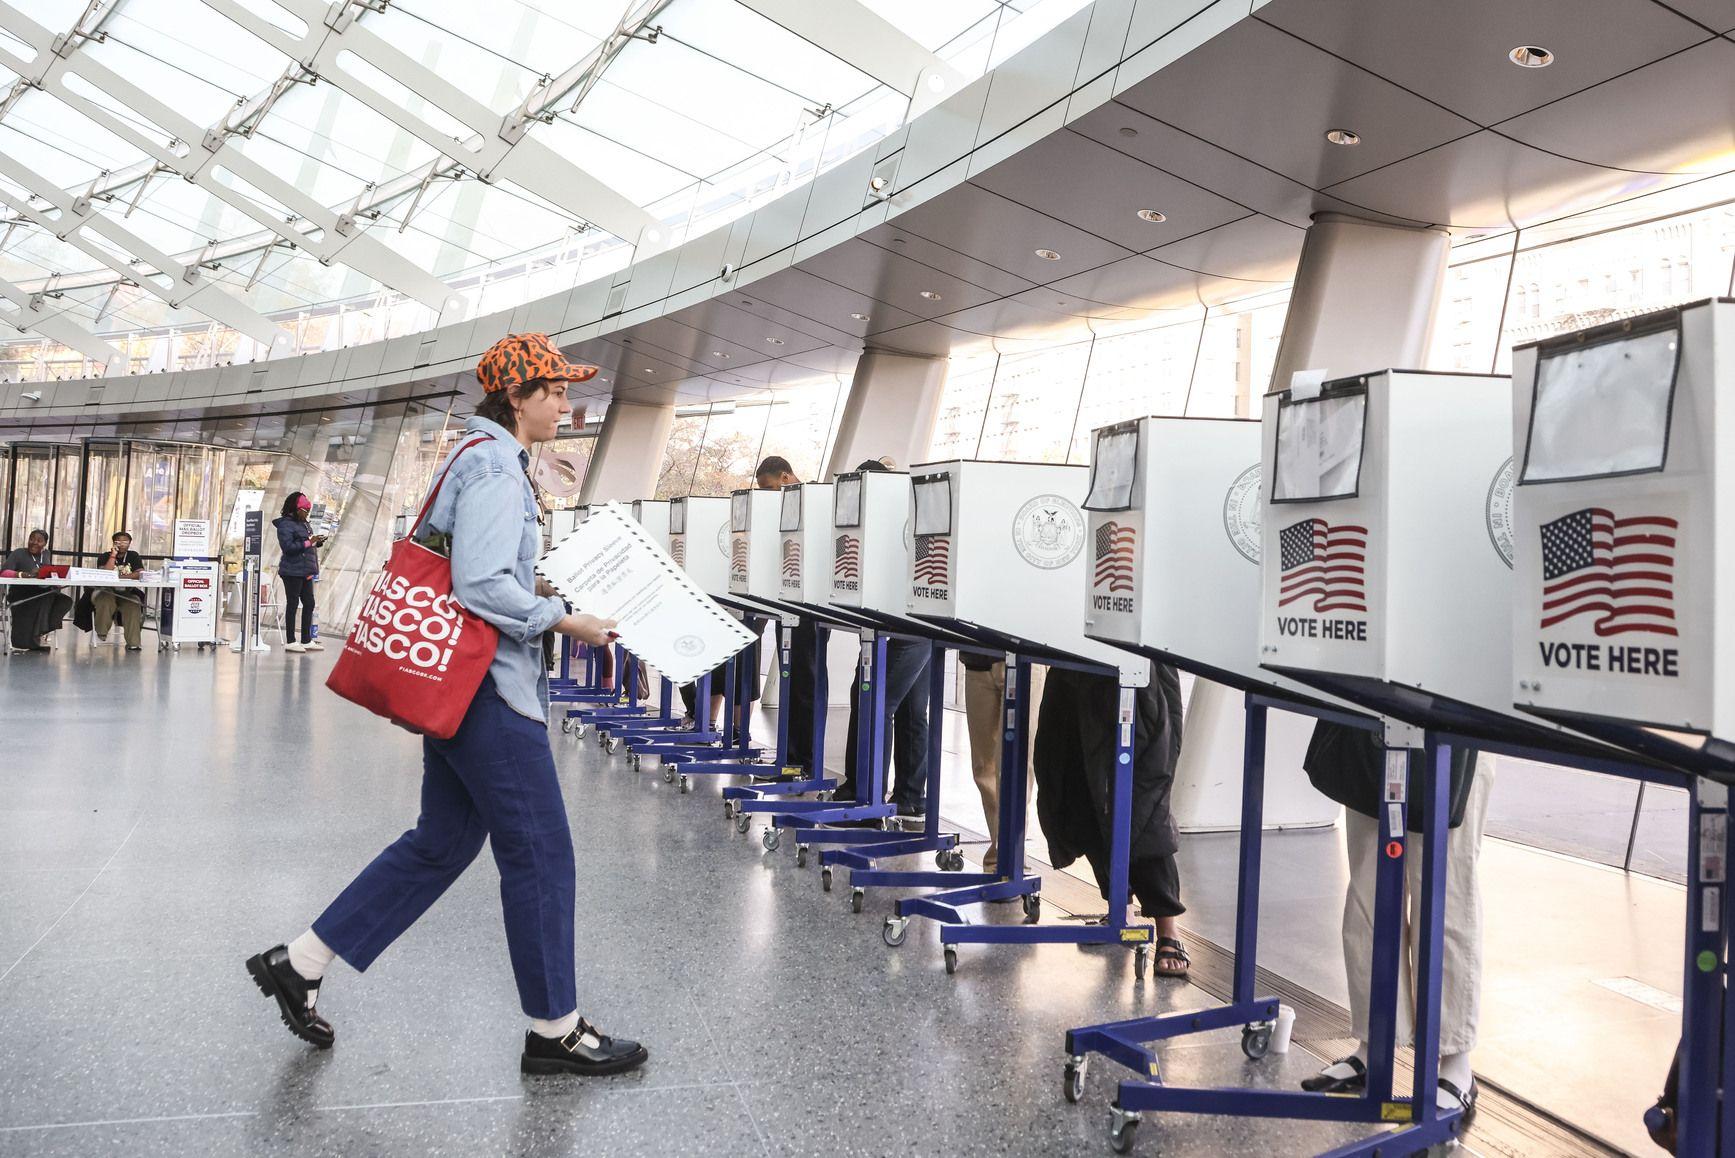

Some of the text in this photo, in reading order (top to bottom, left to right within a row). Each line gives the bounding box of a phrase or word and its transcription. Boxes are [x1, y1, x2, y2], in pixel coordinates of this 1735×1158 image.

[567, 568, 584, 583] Ballot
[583, 552, 604, 569] Privacy
[574, 574, 596, 592] Carpeta
[587, 580, 600, 592] para
[834, 580, 858, 590] VOTE HERE
[913, 586, 948, 600] VOTE HERE
[374, 570, 464, 628] IASCO
[1093, 595, 1133, 613] VOTE HERE
[363, 594, 462, 646] IASCO!
[1277, 616, 1367, 641] VOTE HERE
[1539, 641, 1679, 677] VOTE HERE
